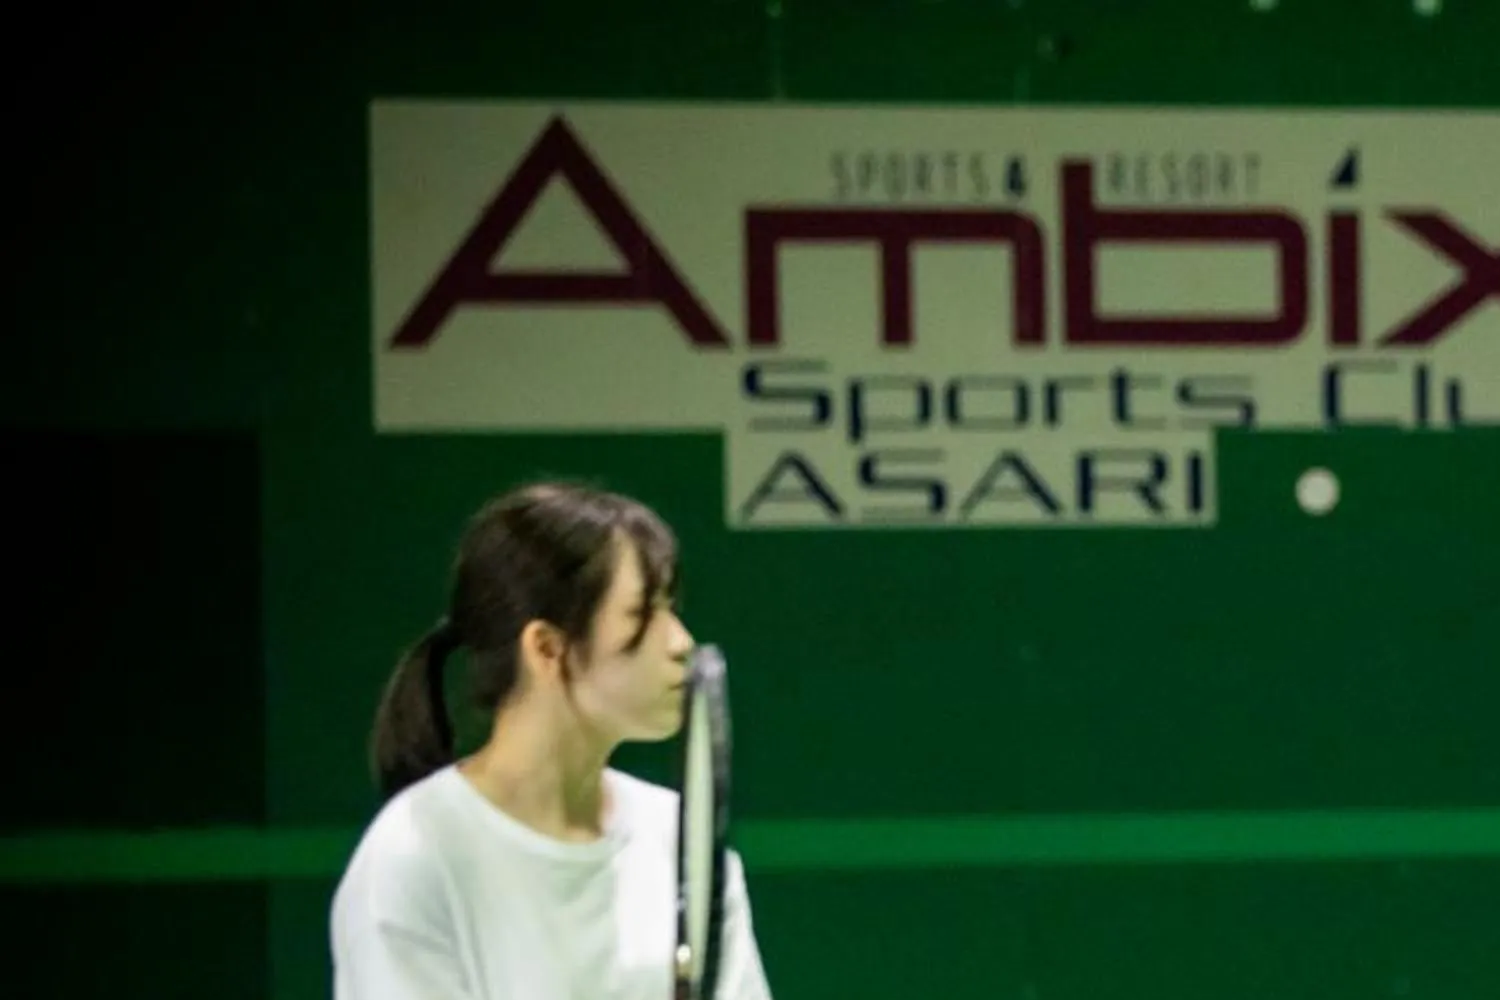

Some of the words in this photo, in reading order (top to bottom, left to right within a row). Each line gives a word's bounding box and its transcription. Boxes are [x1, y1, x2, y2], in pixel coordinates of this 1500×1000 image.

[828, 152, 993, 196] SPORTS
[1106, 152, 1262, 196] RESORT
[743, 359, 1256, 442] Sports
[740, 448, 1204, 522] ASARI
